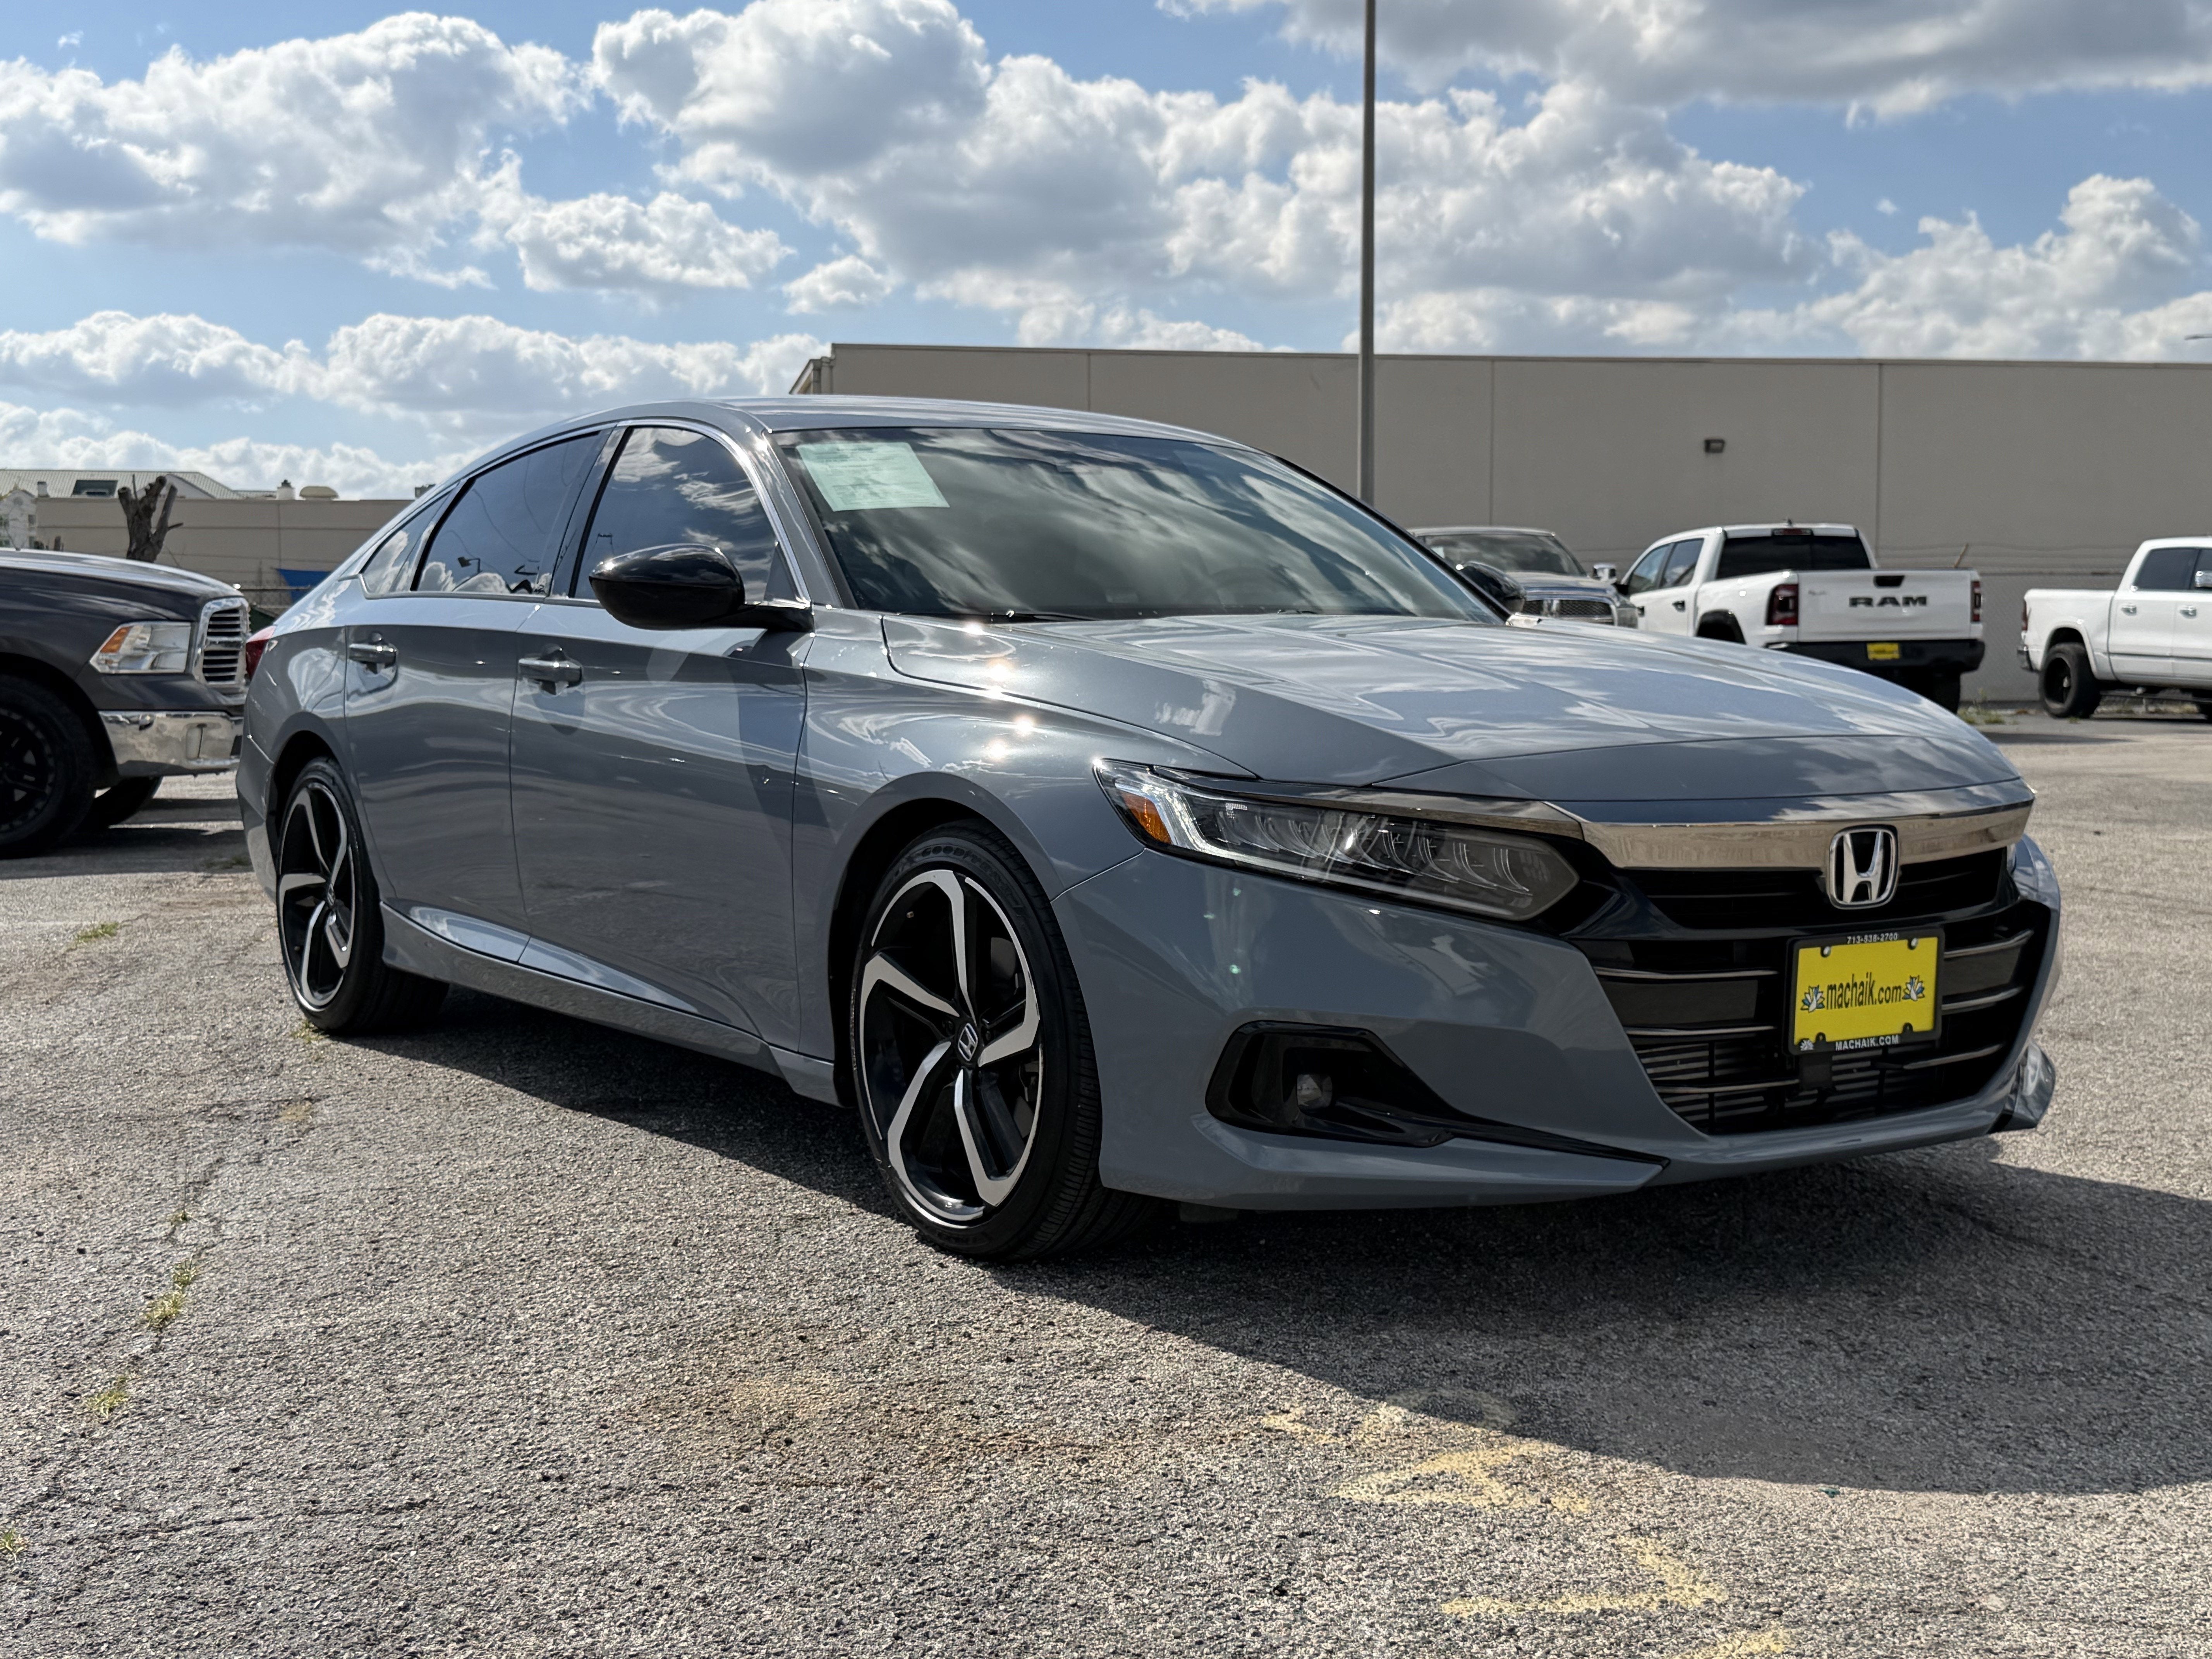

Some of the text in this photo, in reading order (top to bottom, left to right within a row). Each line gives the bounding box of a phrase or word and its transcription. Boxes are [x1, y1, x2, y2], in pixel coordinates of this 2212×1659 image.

[1849, 596, 1927, 607] RAM
[1826, 972, 1901, 1010] machaik.com
[1835, 1034, 1899, 1051] MACHAIK.COM
